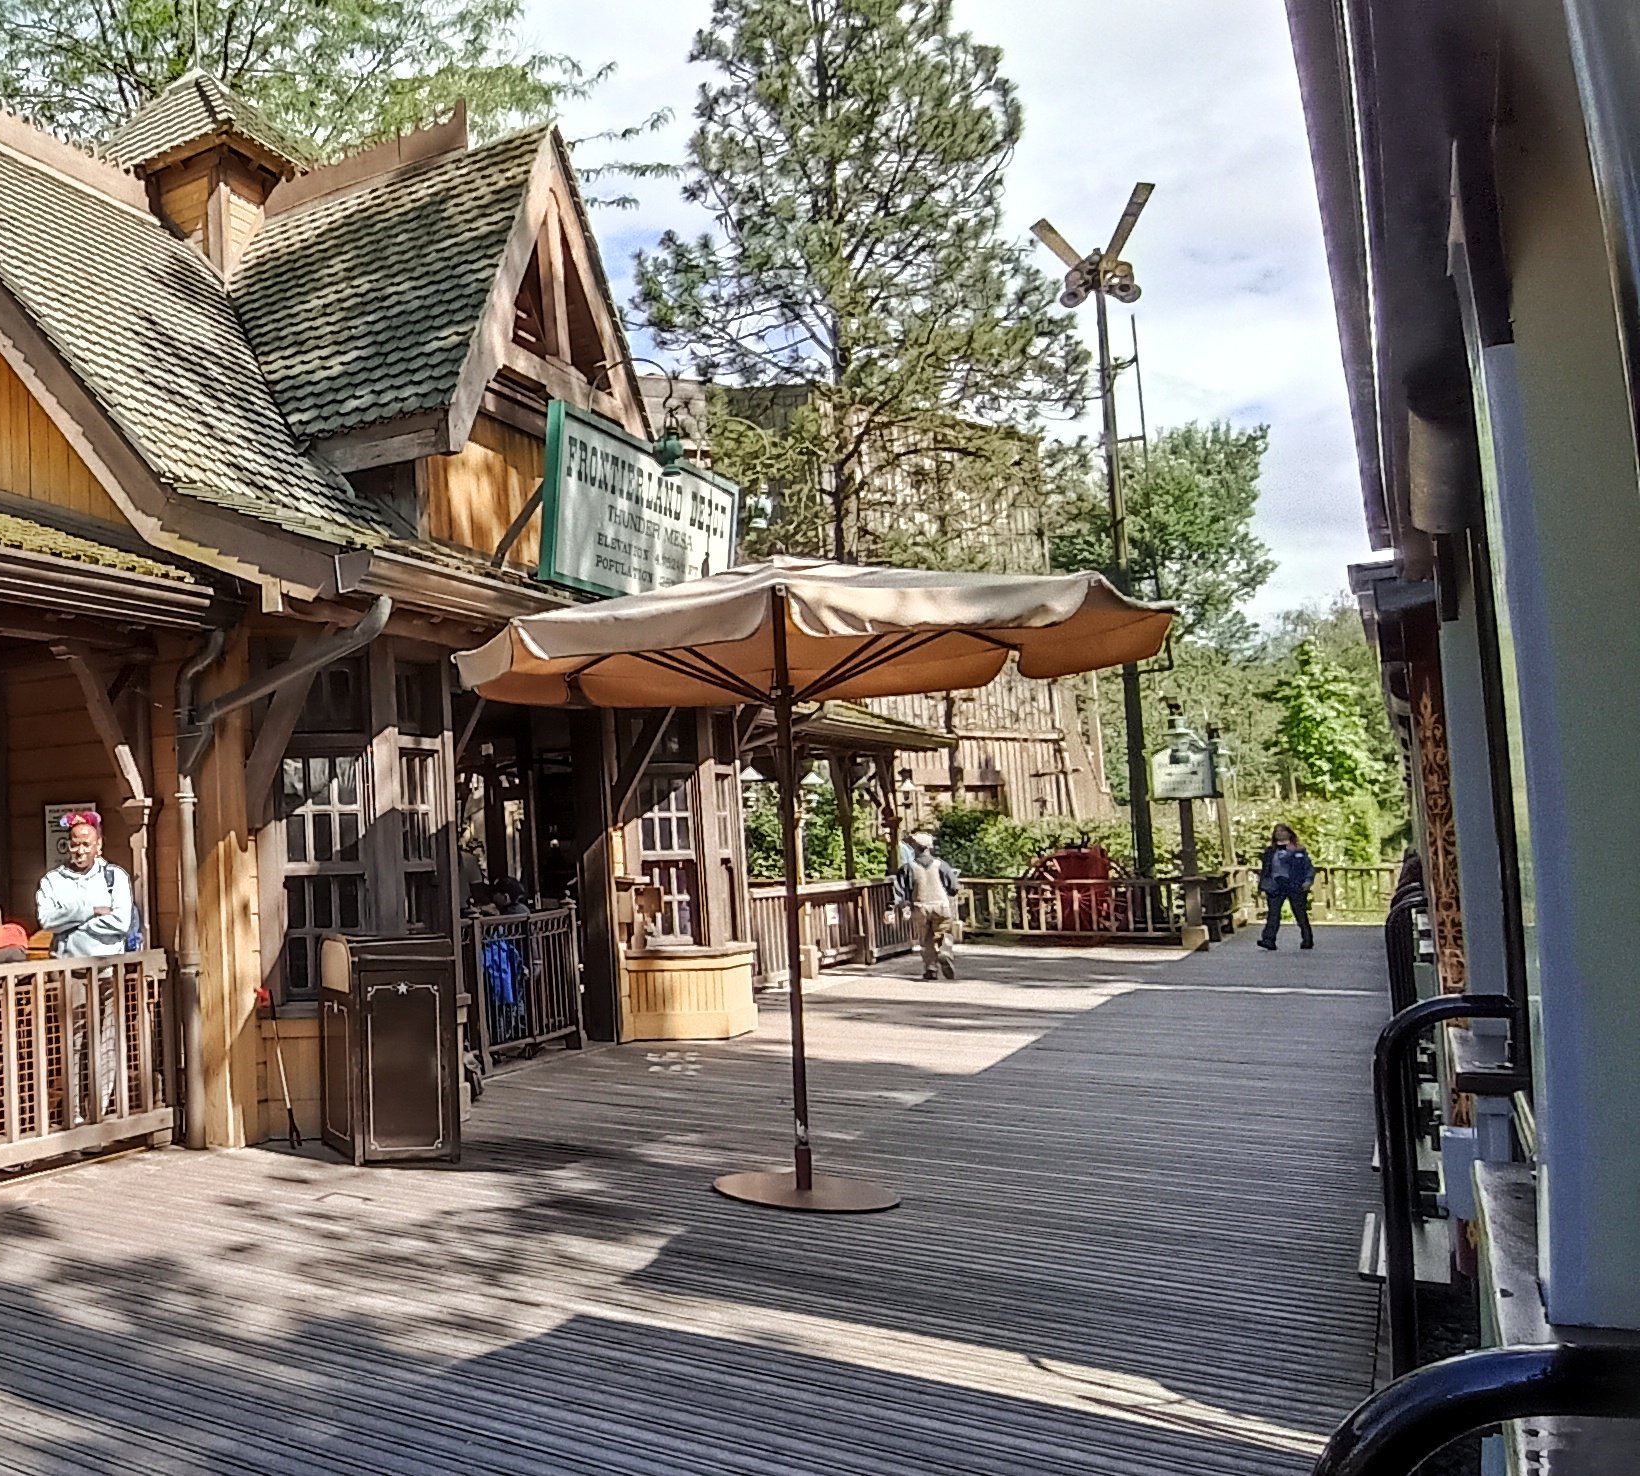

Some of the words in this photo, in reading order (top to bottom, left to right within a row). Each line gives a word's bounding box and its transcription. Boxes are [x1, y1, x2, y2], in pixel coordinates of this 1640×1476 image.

[566, 435, 683, 521] FRONTIERLAND
[689, 490, 727, 539] DEPOT
[597, 531, 650, 561] ELEVATION
[607, 504, 661, 541] THUNDER
[663, 526, 693, 552] MESA
[595, 554, 654, 584] POPULATION
